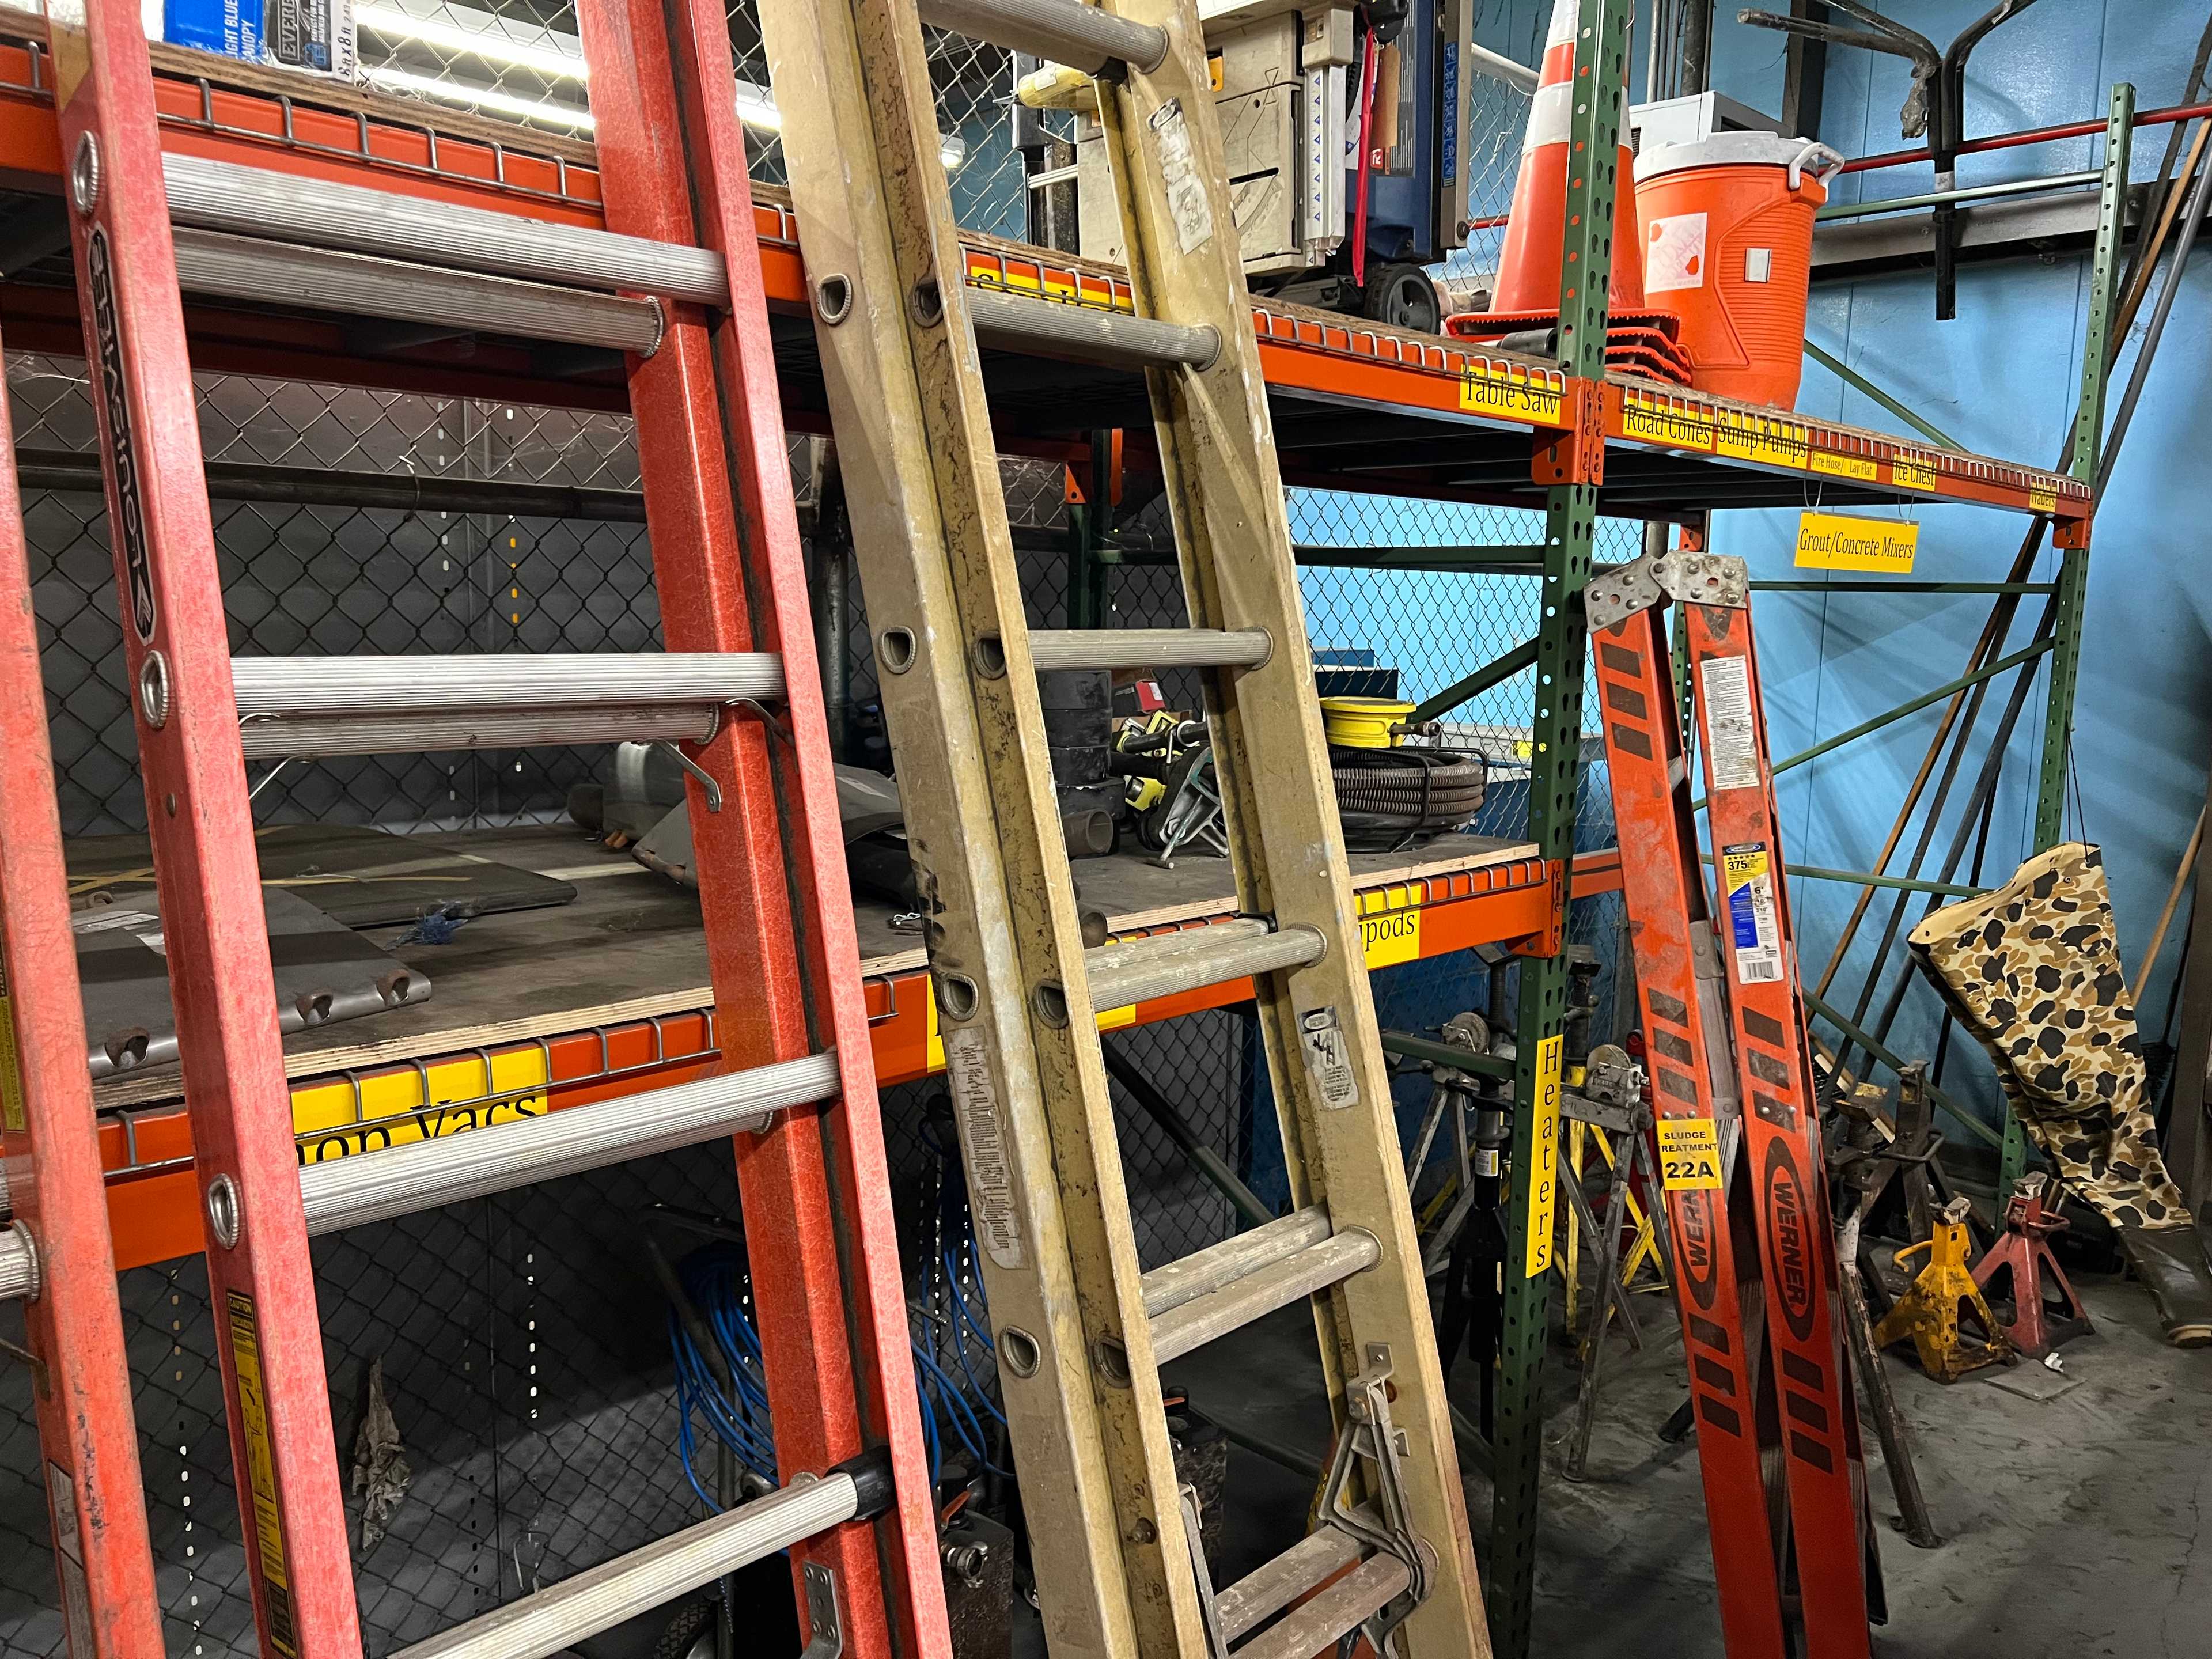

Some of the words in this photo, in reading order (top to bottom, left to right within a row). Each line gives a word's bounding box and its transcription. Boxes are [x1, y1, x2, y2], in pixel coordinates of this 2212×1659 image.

[1467, 372, 1515, 408] Table
[1521, 382, 1558, 415] Saw
[1627, 408, 1664, 437] Road
[1669, 414, 1710, 445] Cones
[1718, 416, 1758, 456] Sump
[1763, 425, 1806, 463] Pumps
[1812, 453, 1825, 467] Fire
[1850, 461, 1861, 476] Lay
[1861, 463, 1872, 476] Flat
[1895, 460, 1908, 480] Ice
[1910, 463, 1934, 486] Chest
[1800, 528, 1880, 558] Grout/Concrete
[1881, 536, 1914, 559] Mixers
[1728, 860, 1747, 870] 375
[1664, 1131, 1706, 1140] SLUDGE
[1536, 1041, 1559, 1268] Heaters
[1665, 1161, 1715, 1179] 22A
[1774, 1182, 1807, 1306] WERNER
